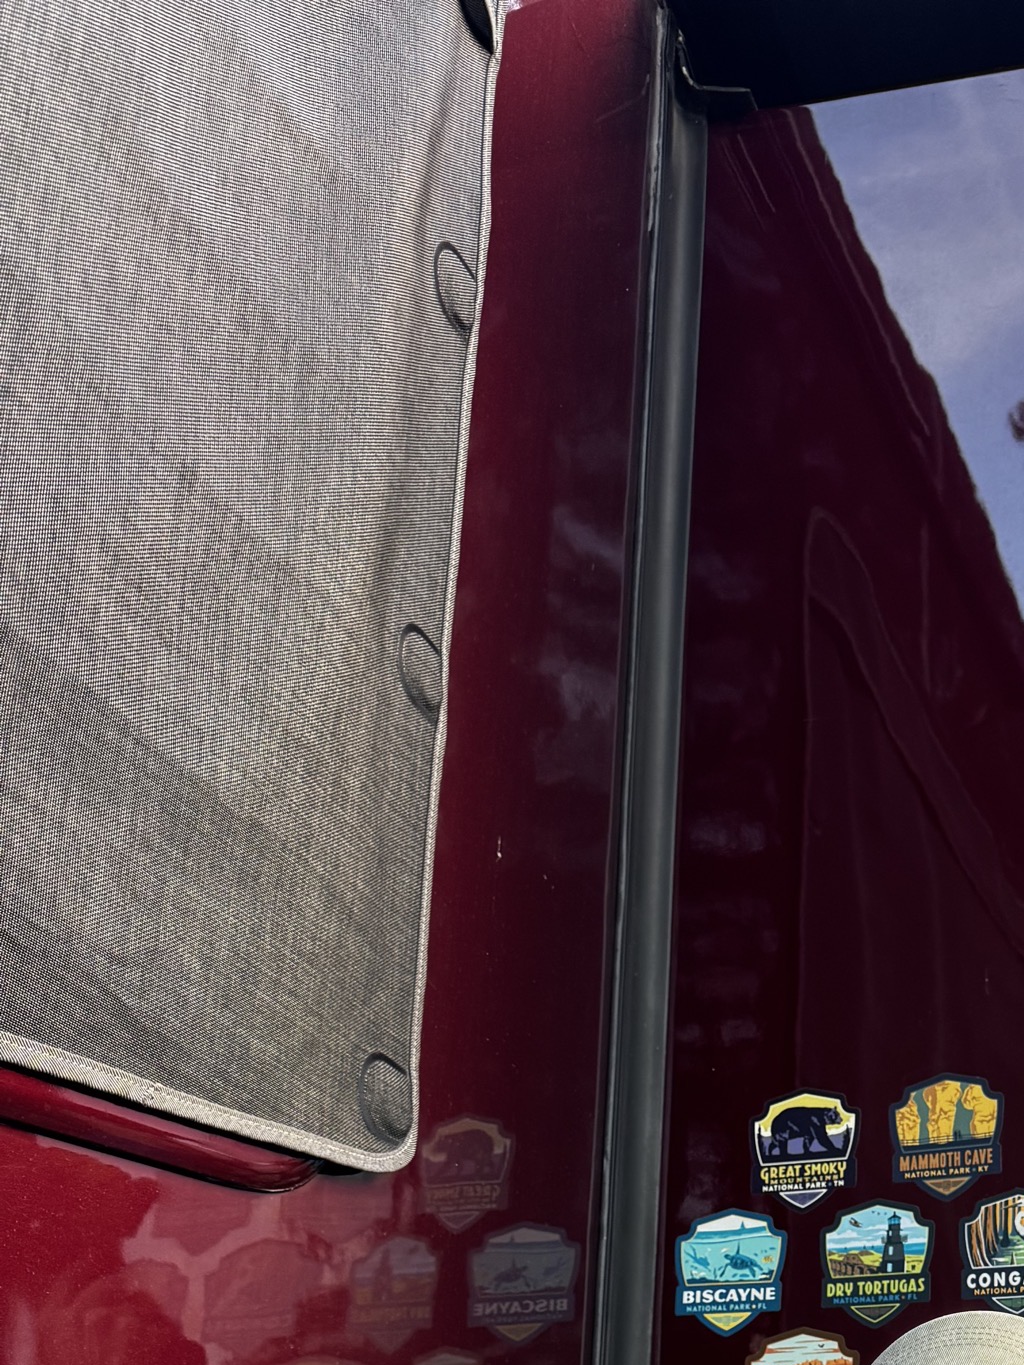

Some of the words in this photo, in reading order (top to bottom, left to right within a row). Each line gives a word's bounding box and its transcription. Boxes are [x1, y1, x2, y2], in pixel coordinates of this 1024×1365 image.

[899, 1151, 961, 1172] MAMMOTH
[964, 1148, 993, 1166] CAVE
[760, 1165, 802, 1184] GREAT
[804, 1161, 847, 1179] SMOKY
[904, 1169, 947, 1179] NATIONAL
[949, 1167, 971, 1175] PARK
[770, 1175, 838, 1185] MOUNTAINS
[762, 1184, 804, 1193] NATIONAL
[805, 1181, 827, 1189] PARK
[826, 1282, 854, 1298] DRY
[857, 1277, 925, 1295] TORTUGAS
[974, 1287, 1017, 1296] NATIONAL
[682, 1287, 776, 1304] BISCAYNE
[833, 1296, 876, 1304] NATIONAL
[878, 1294, 900, 1302] PARK
[686, 1304, 727, 1312] NATIONAL
[729, 1303, 751, 1311] PARK
